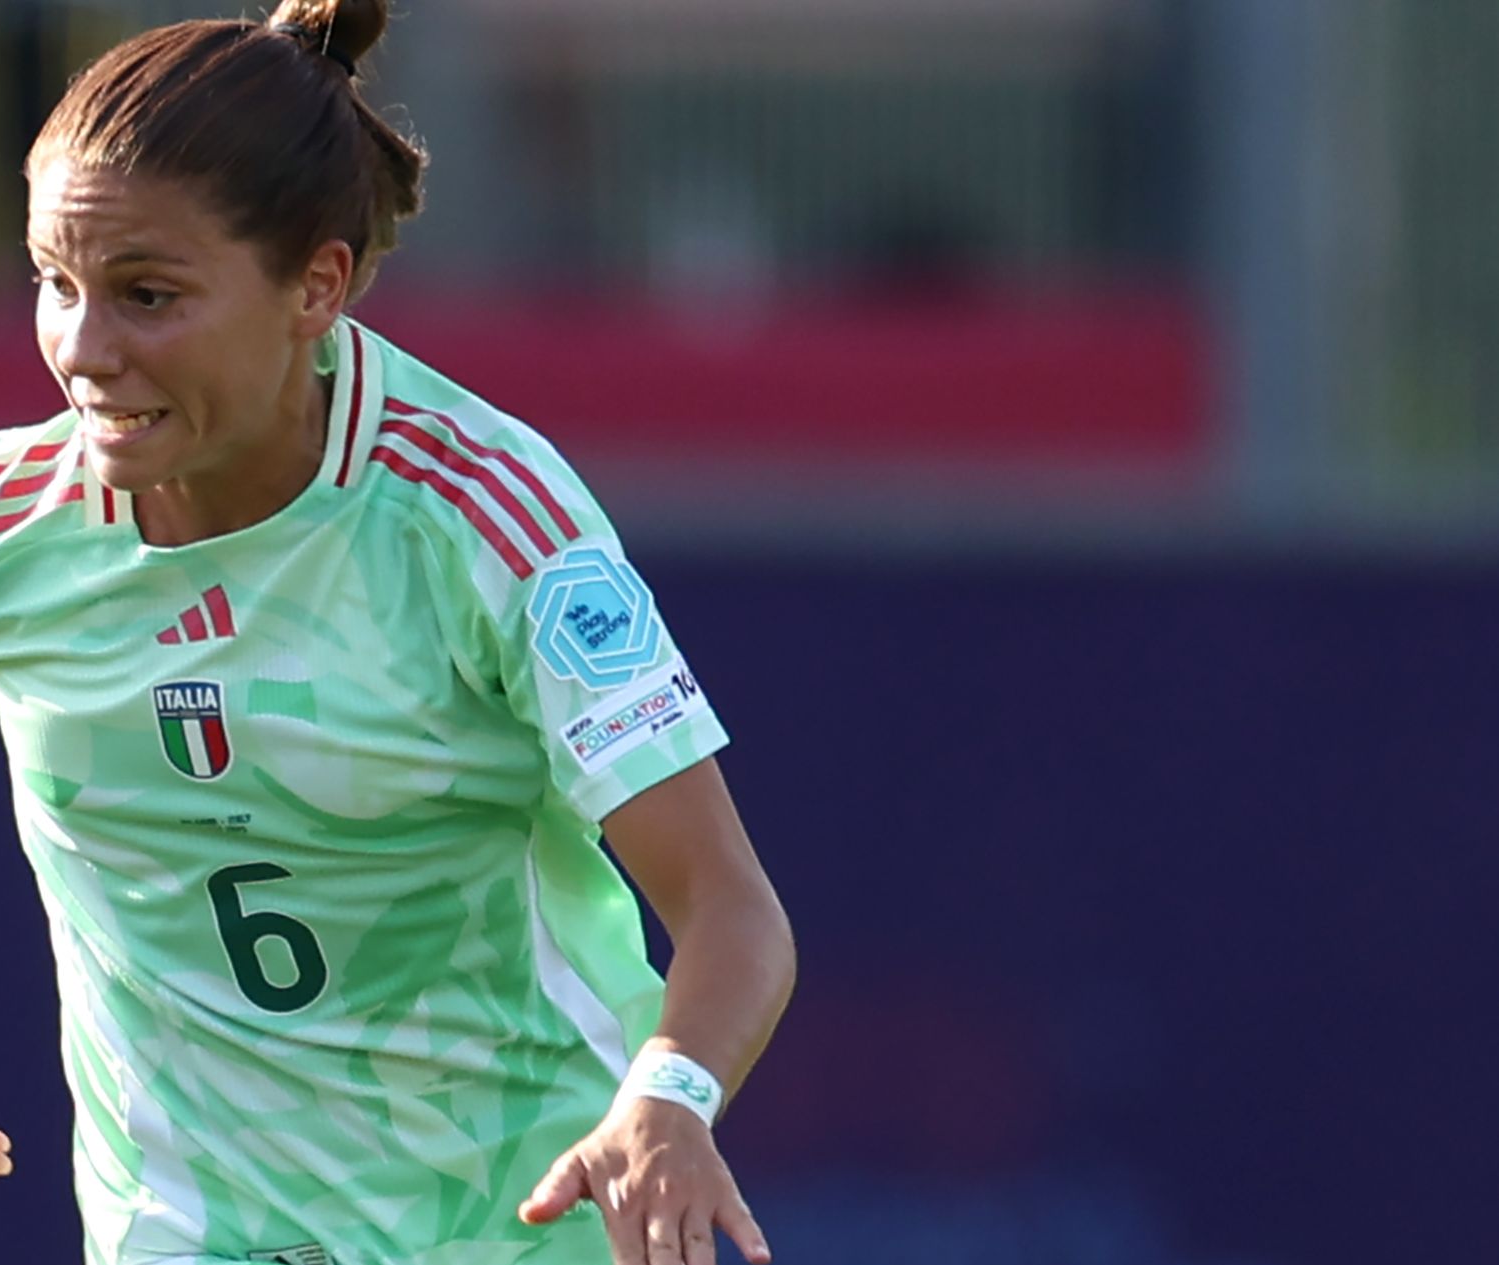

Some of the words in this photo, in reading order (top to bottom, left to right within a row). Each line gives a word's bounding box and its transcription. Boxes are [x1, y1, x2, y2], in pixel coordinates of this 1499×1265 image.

[156, 688, 218, 711] ITALIA
[574, 687, 676, 758] FOUNDATION
[205, 861, 329, 1015] 6
